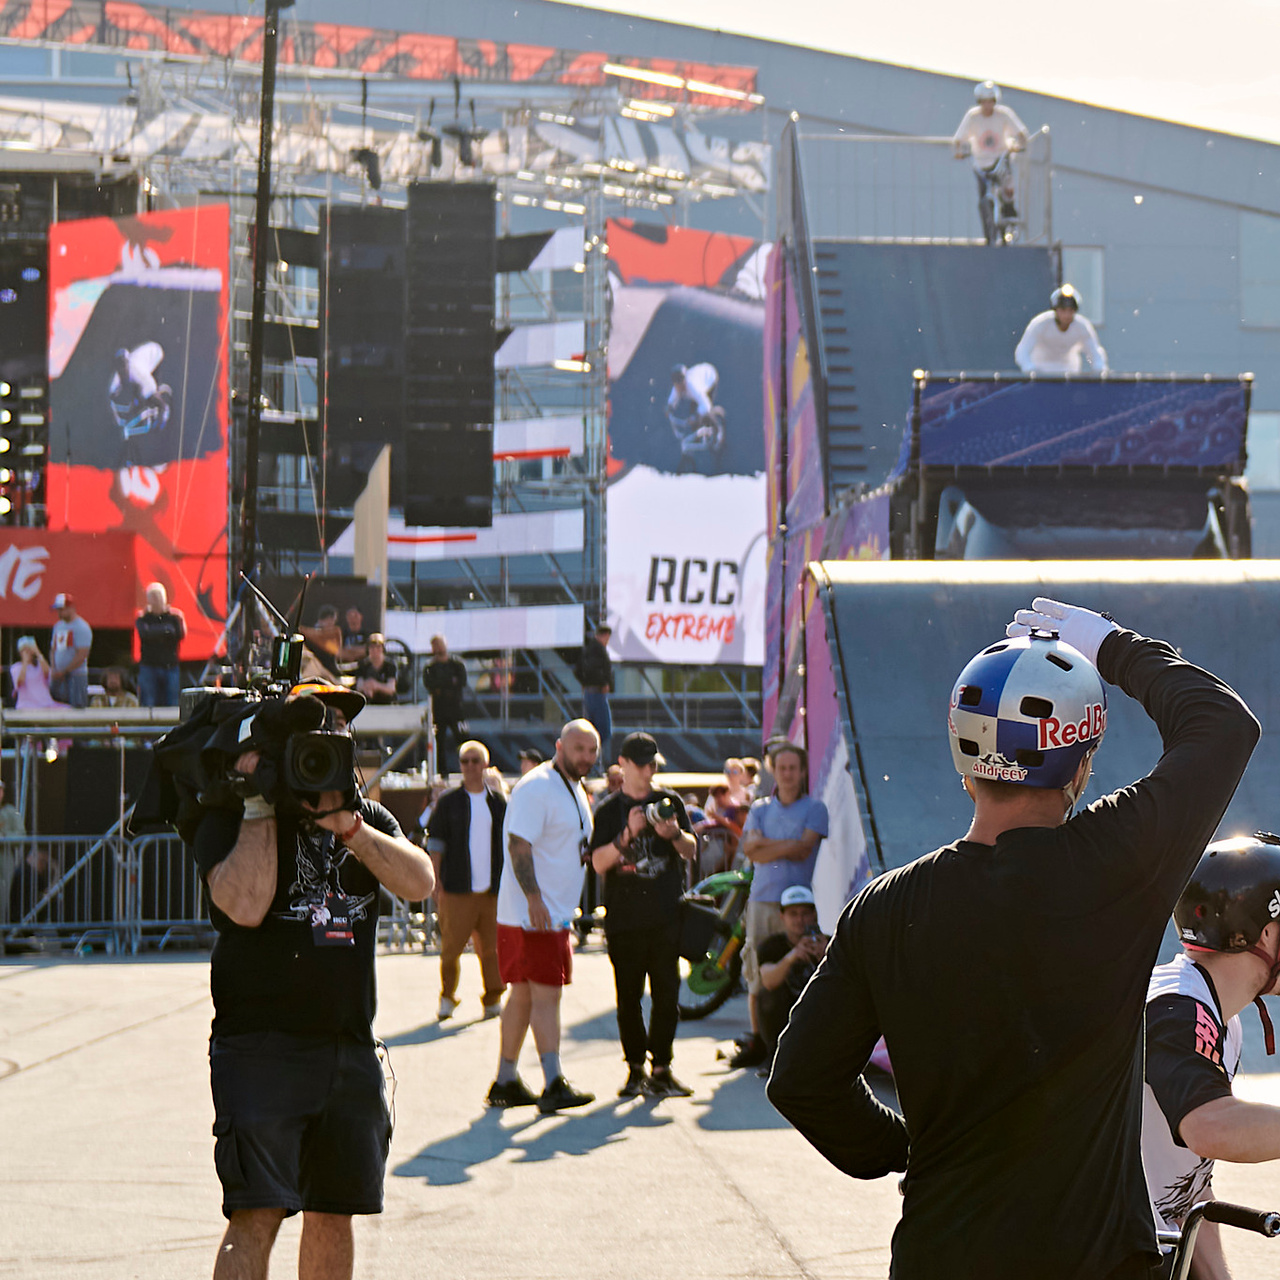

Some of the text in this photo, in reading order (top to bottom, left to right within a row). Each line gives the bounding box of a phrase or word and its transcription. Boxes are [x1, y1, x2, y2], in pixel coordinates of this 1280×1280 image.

[645, 556, 739, 605] RCC
[644, 612, 737, 645] EXTREME
[1038, 704, 1091, 749] Red
